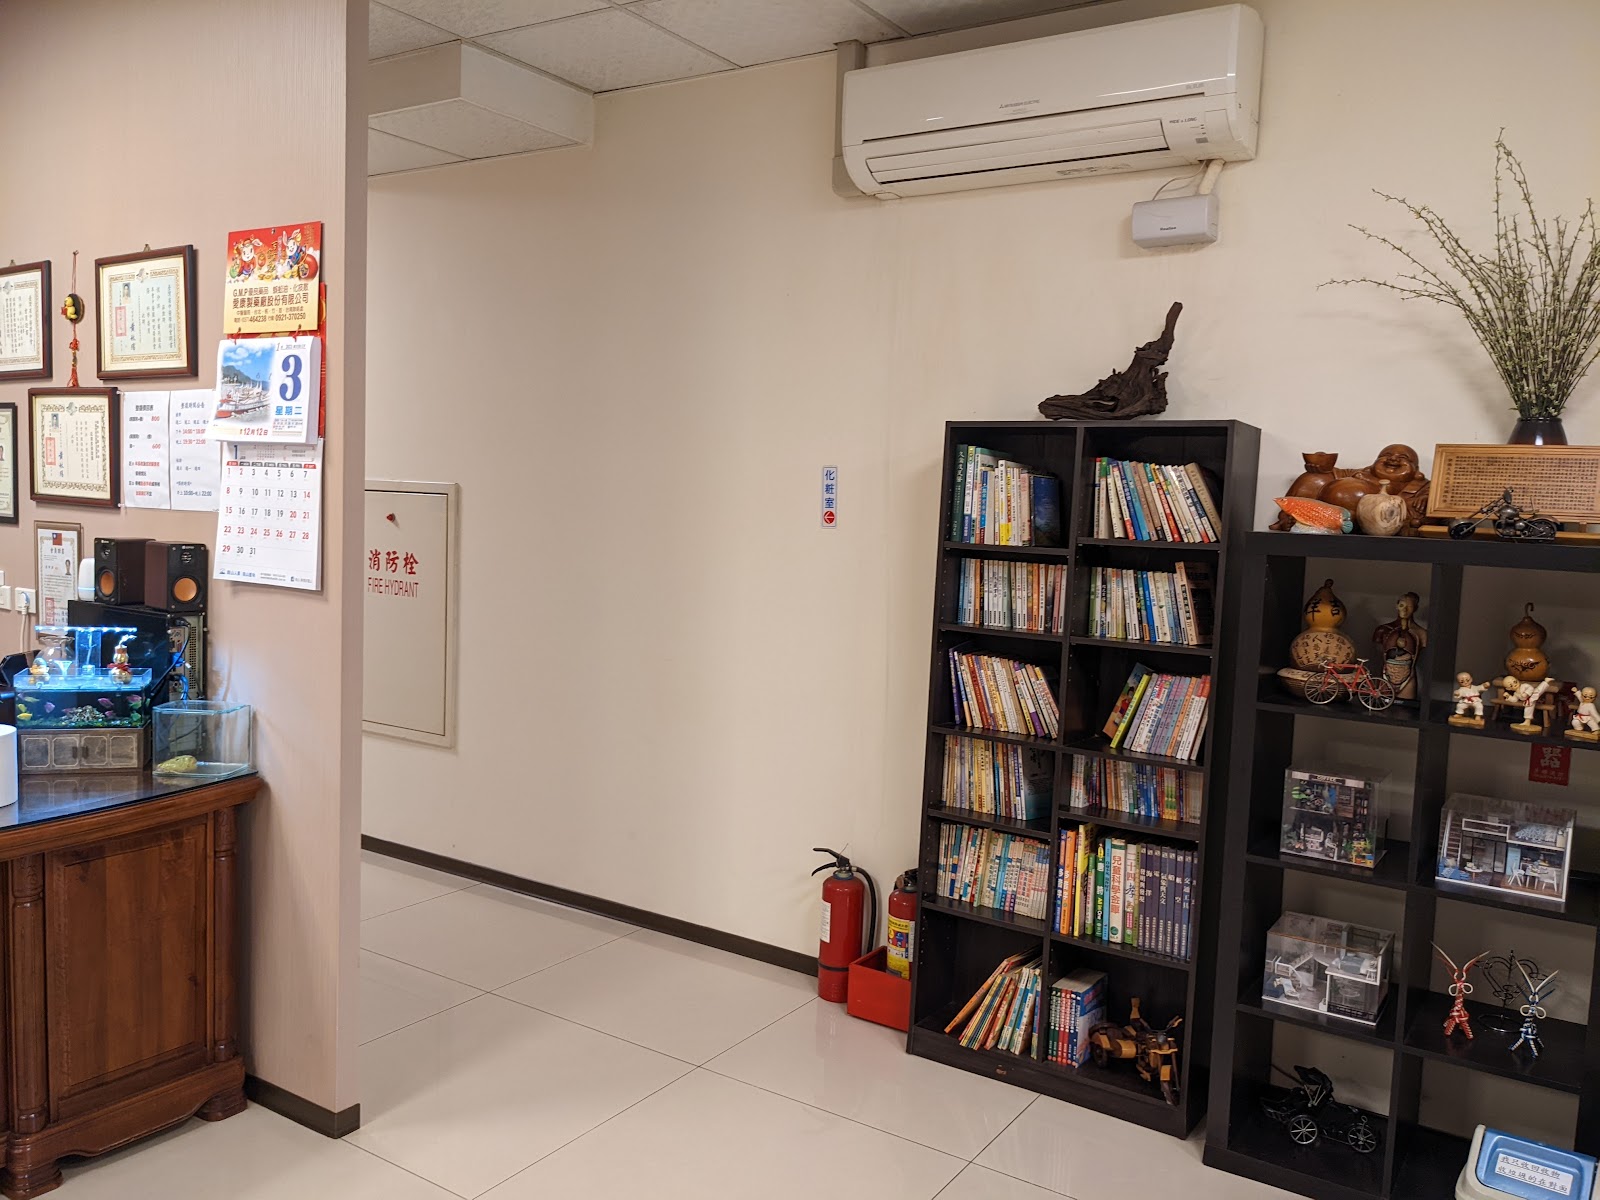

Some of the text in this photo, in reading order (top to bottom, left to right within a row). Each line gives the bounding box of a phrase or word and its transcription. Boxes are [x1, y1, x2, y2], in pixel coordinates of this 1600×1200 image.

[280, 354, 302, 401] 3
[275, 406, 302, 415] 星期二
[368, 549, 418, 574] 消防栓
[368, 577, 418, 598] FIRE HYDRANT
